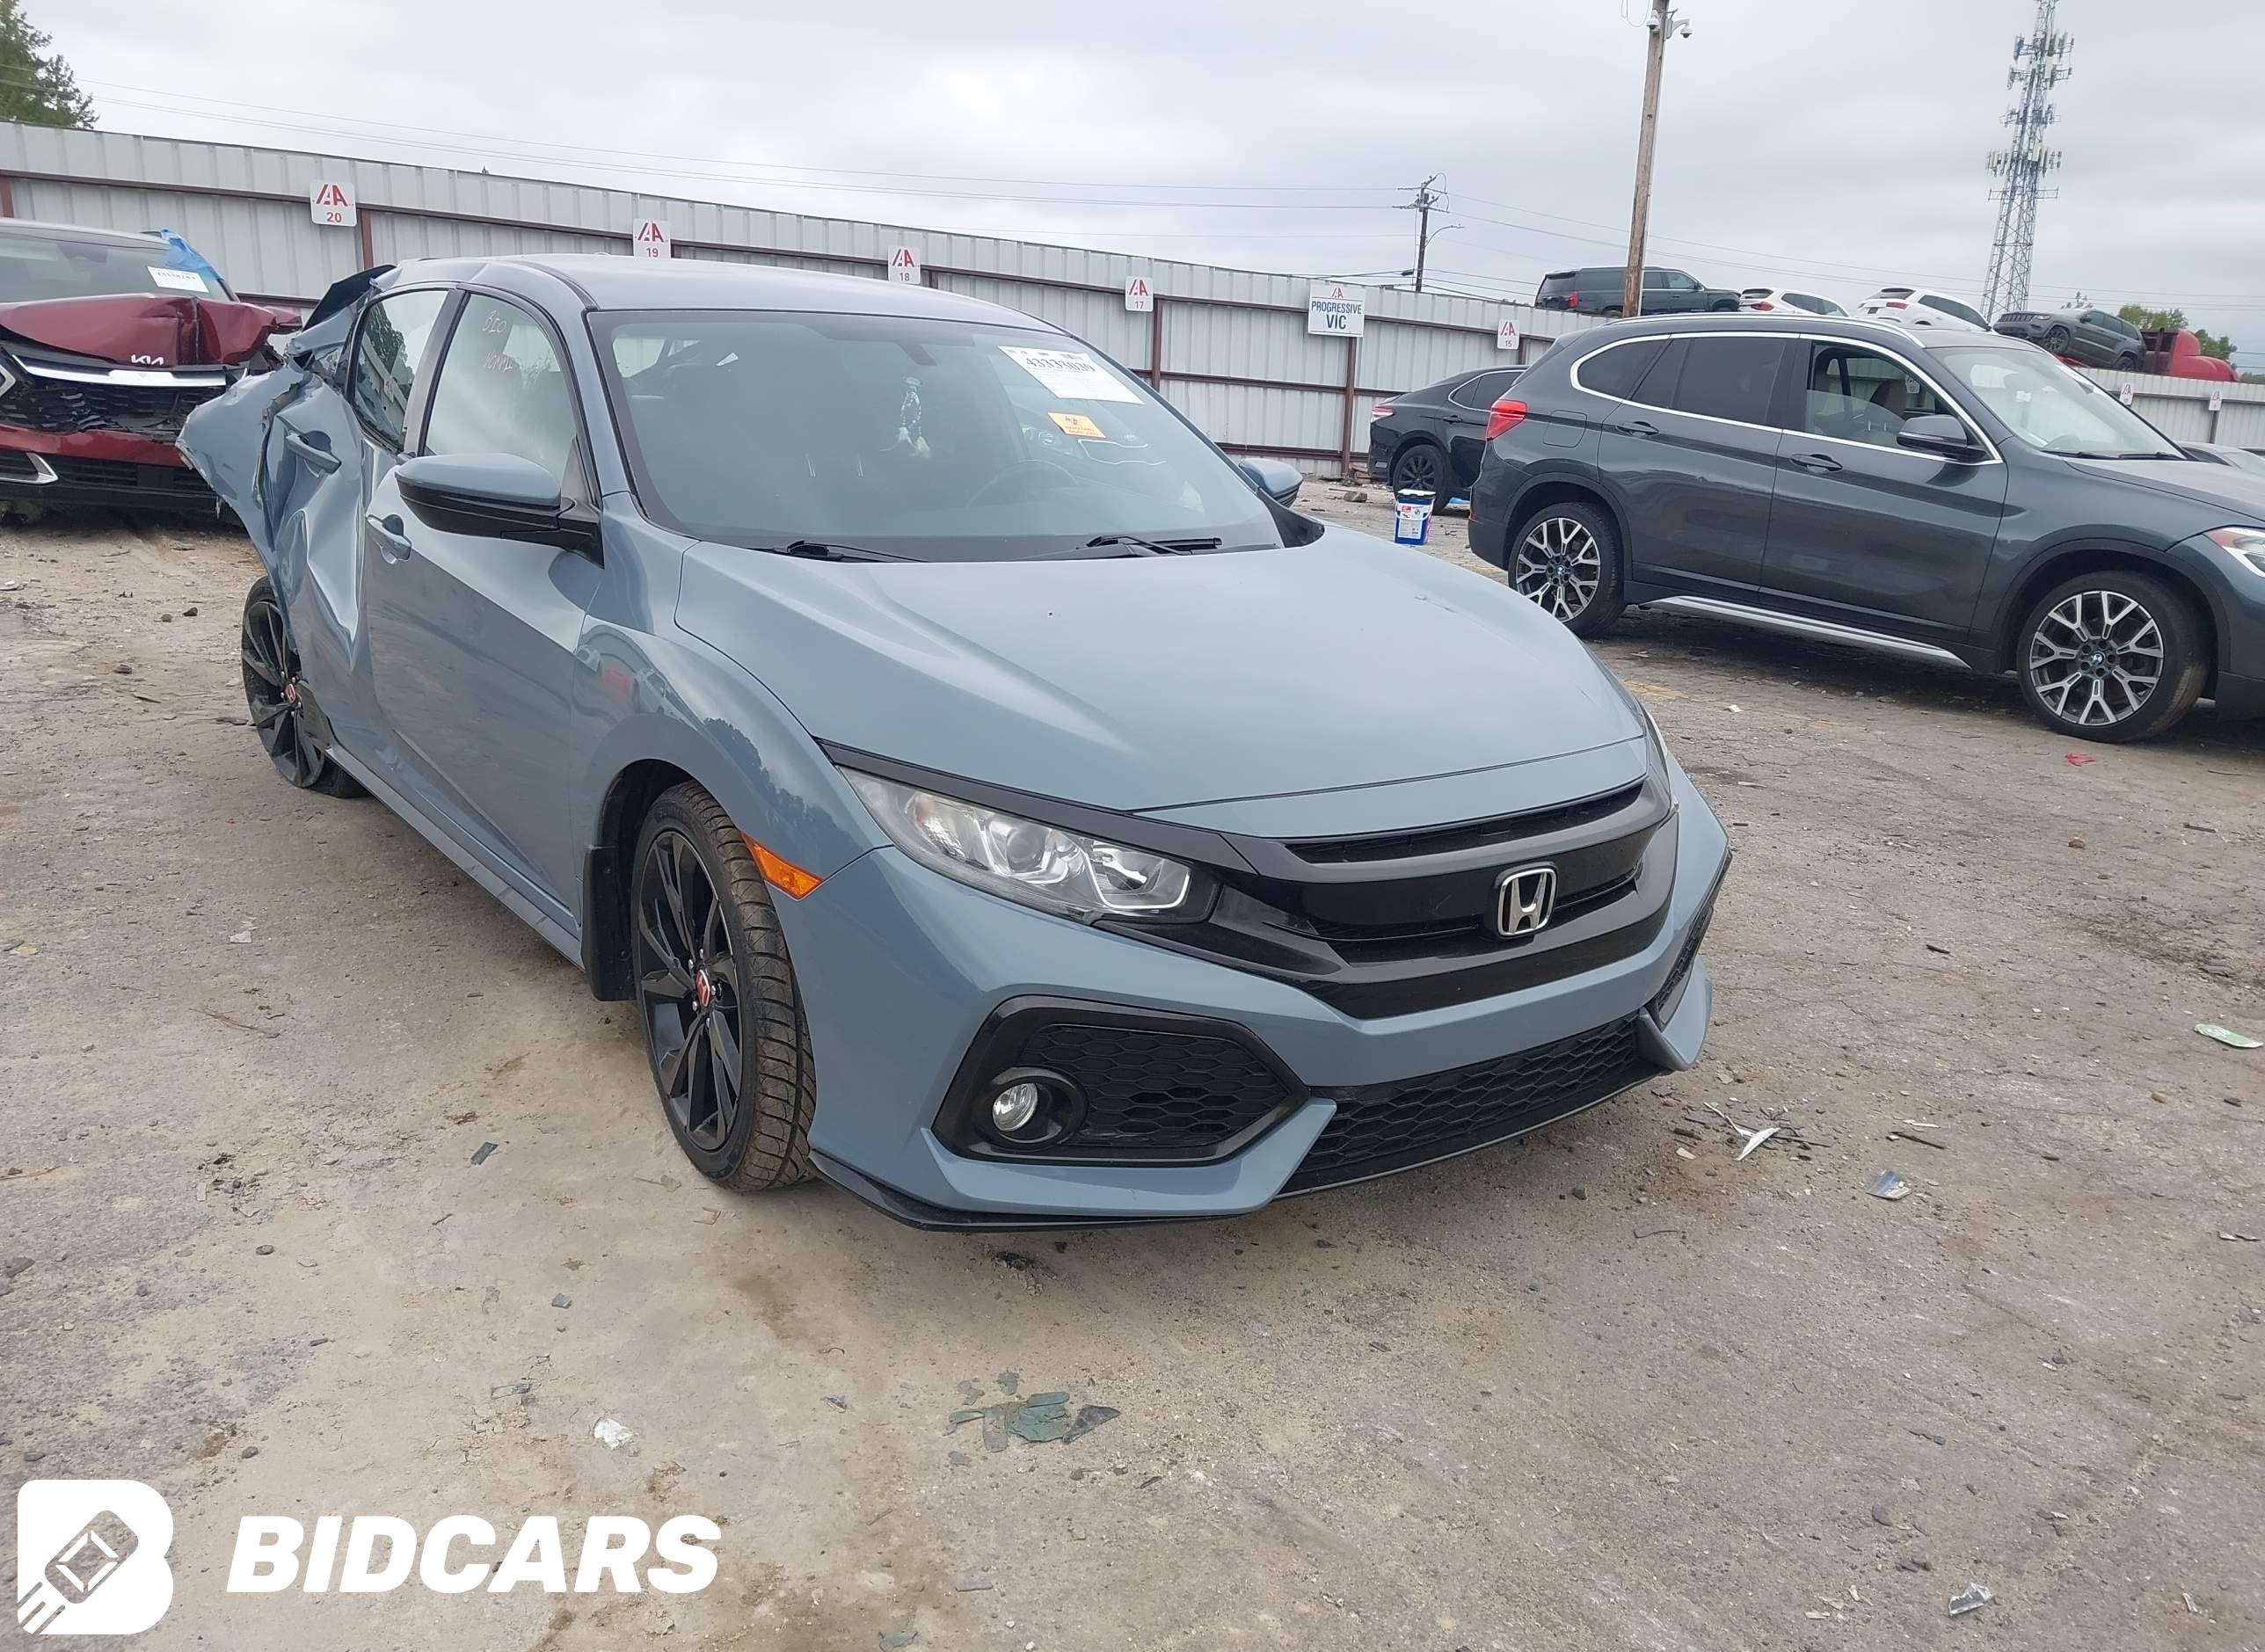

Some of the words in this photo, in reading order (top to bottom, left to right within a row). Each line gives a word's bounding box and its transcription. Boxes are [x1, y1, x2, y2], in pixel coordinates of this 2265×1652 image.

[326, 211, 342, 223] 20
[646, 247, 659, 258] 19
[899, 273, 910, 282] 18
[1134, 301, 1144, 309] 17
[1311, 301, 1362, 315] PROGRESSIVE
[1326, 315, 1347, 330] VIC
[131, 353, 164, 366] KIA
